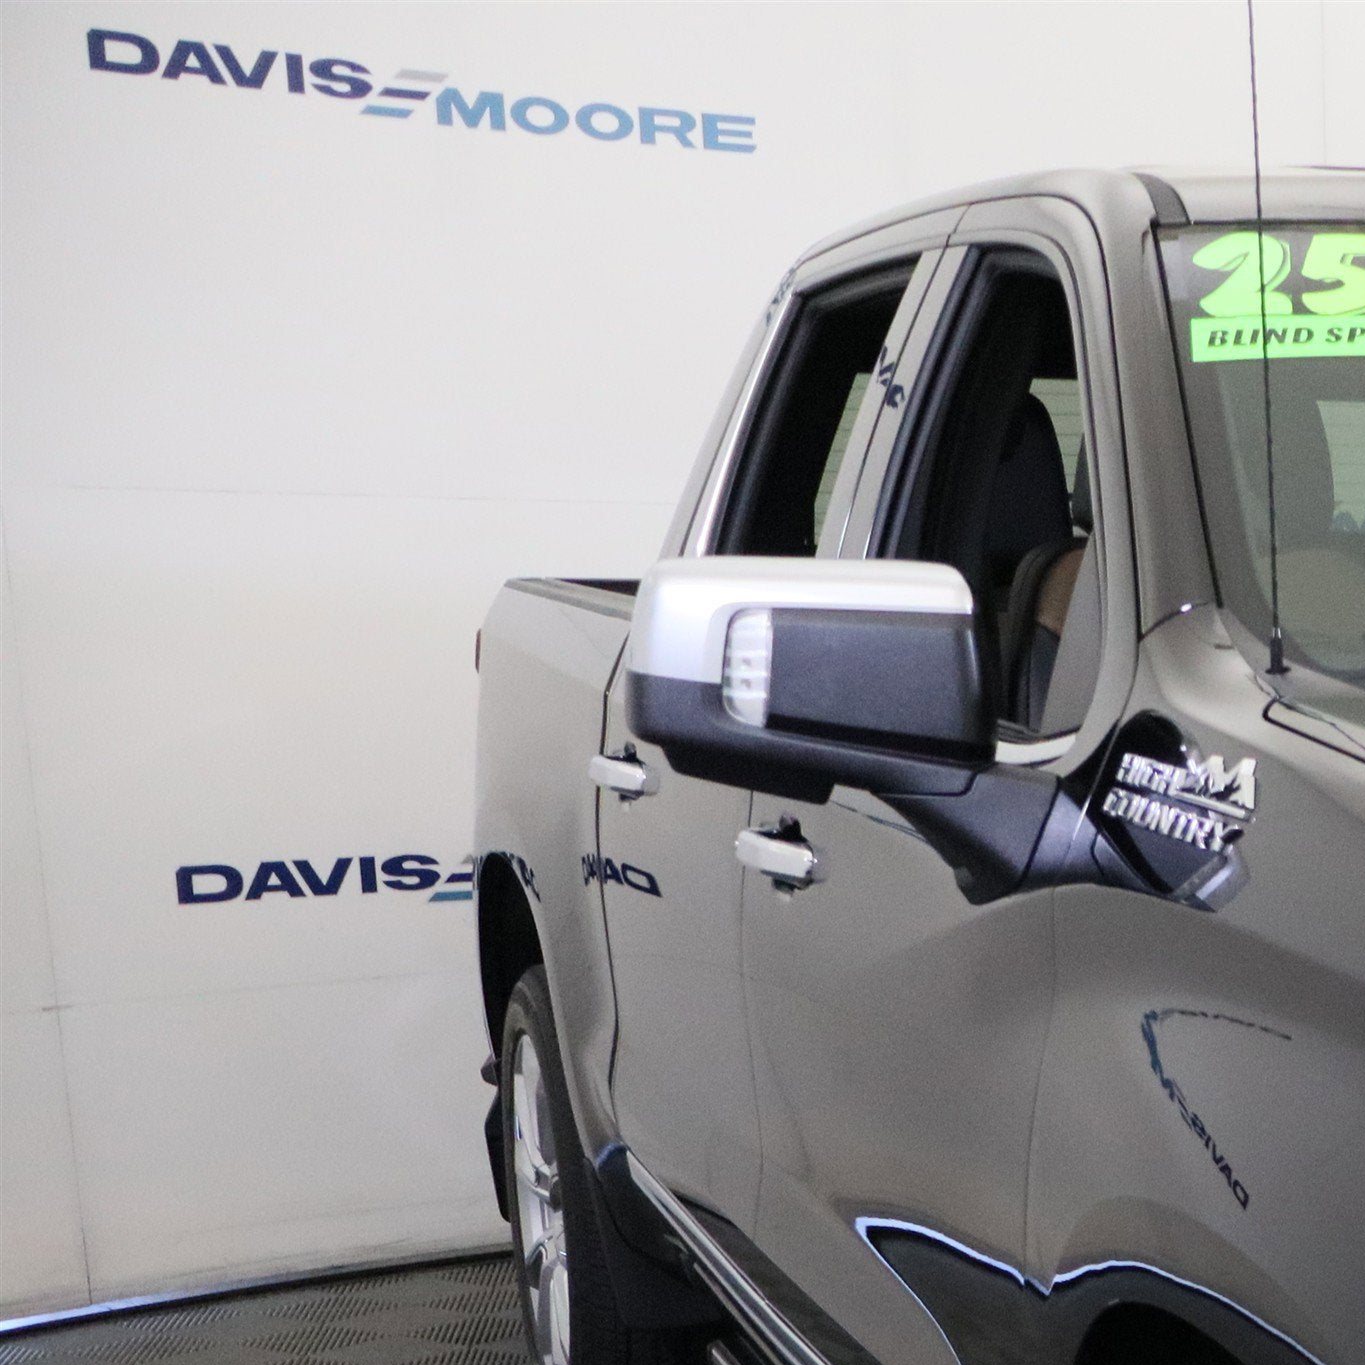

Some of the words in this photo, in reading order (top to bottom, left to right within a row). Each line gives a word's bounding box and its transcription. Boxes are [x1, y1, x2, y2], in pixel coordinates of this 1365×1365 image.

[86, 28, 373, 99] DAVIS
[436, 88, 756, 153] MOORE
[1208, 328, 1314, 348] BLIND
[175, 855, 442, 905] DAVIS
